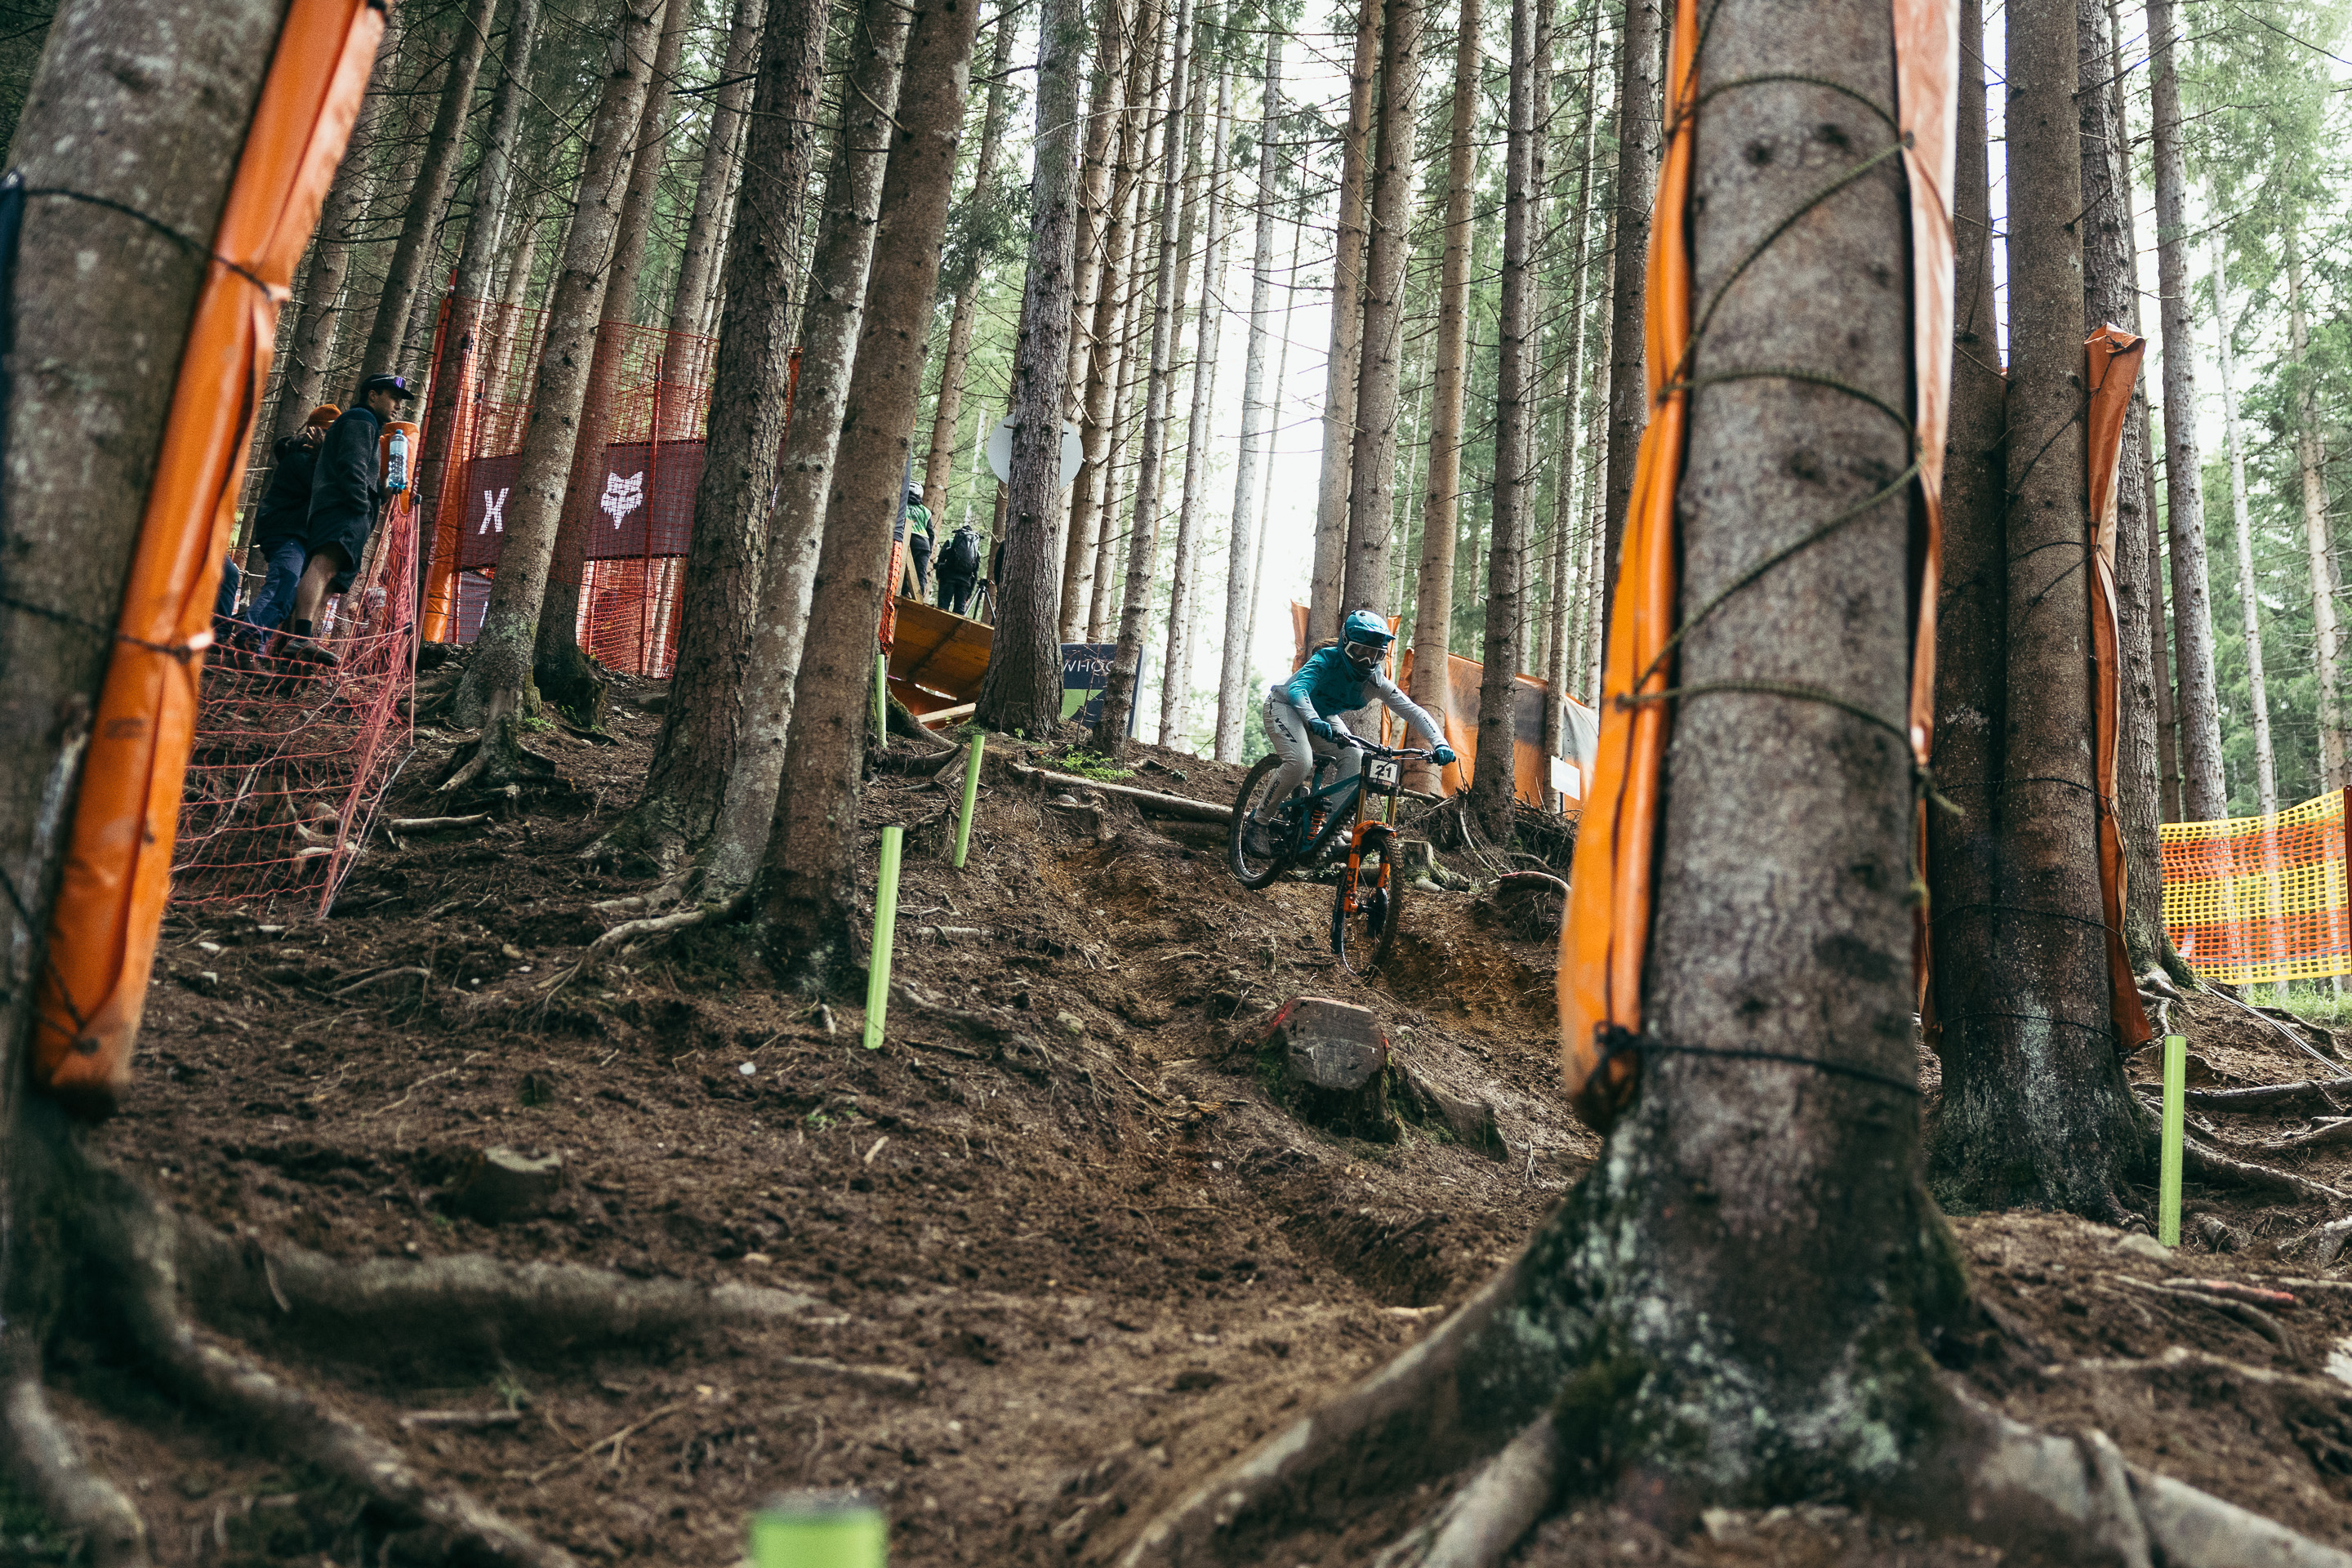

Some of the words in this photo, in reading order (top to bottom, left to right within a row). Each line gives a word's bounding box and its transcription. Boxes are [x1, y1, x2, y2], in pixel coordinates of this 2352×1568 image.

[478, 488, 510, 535] X
[1274, 717, 1298, 744] YETI
[1374, 764, 1392, 778] 21
